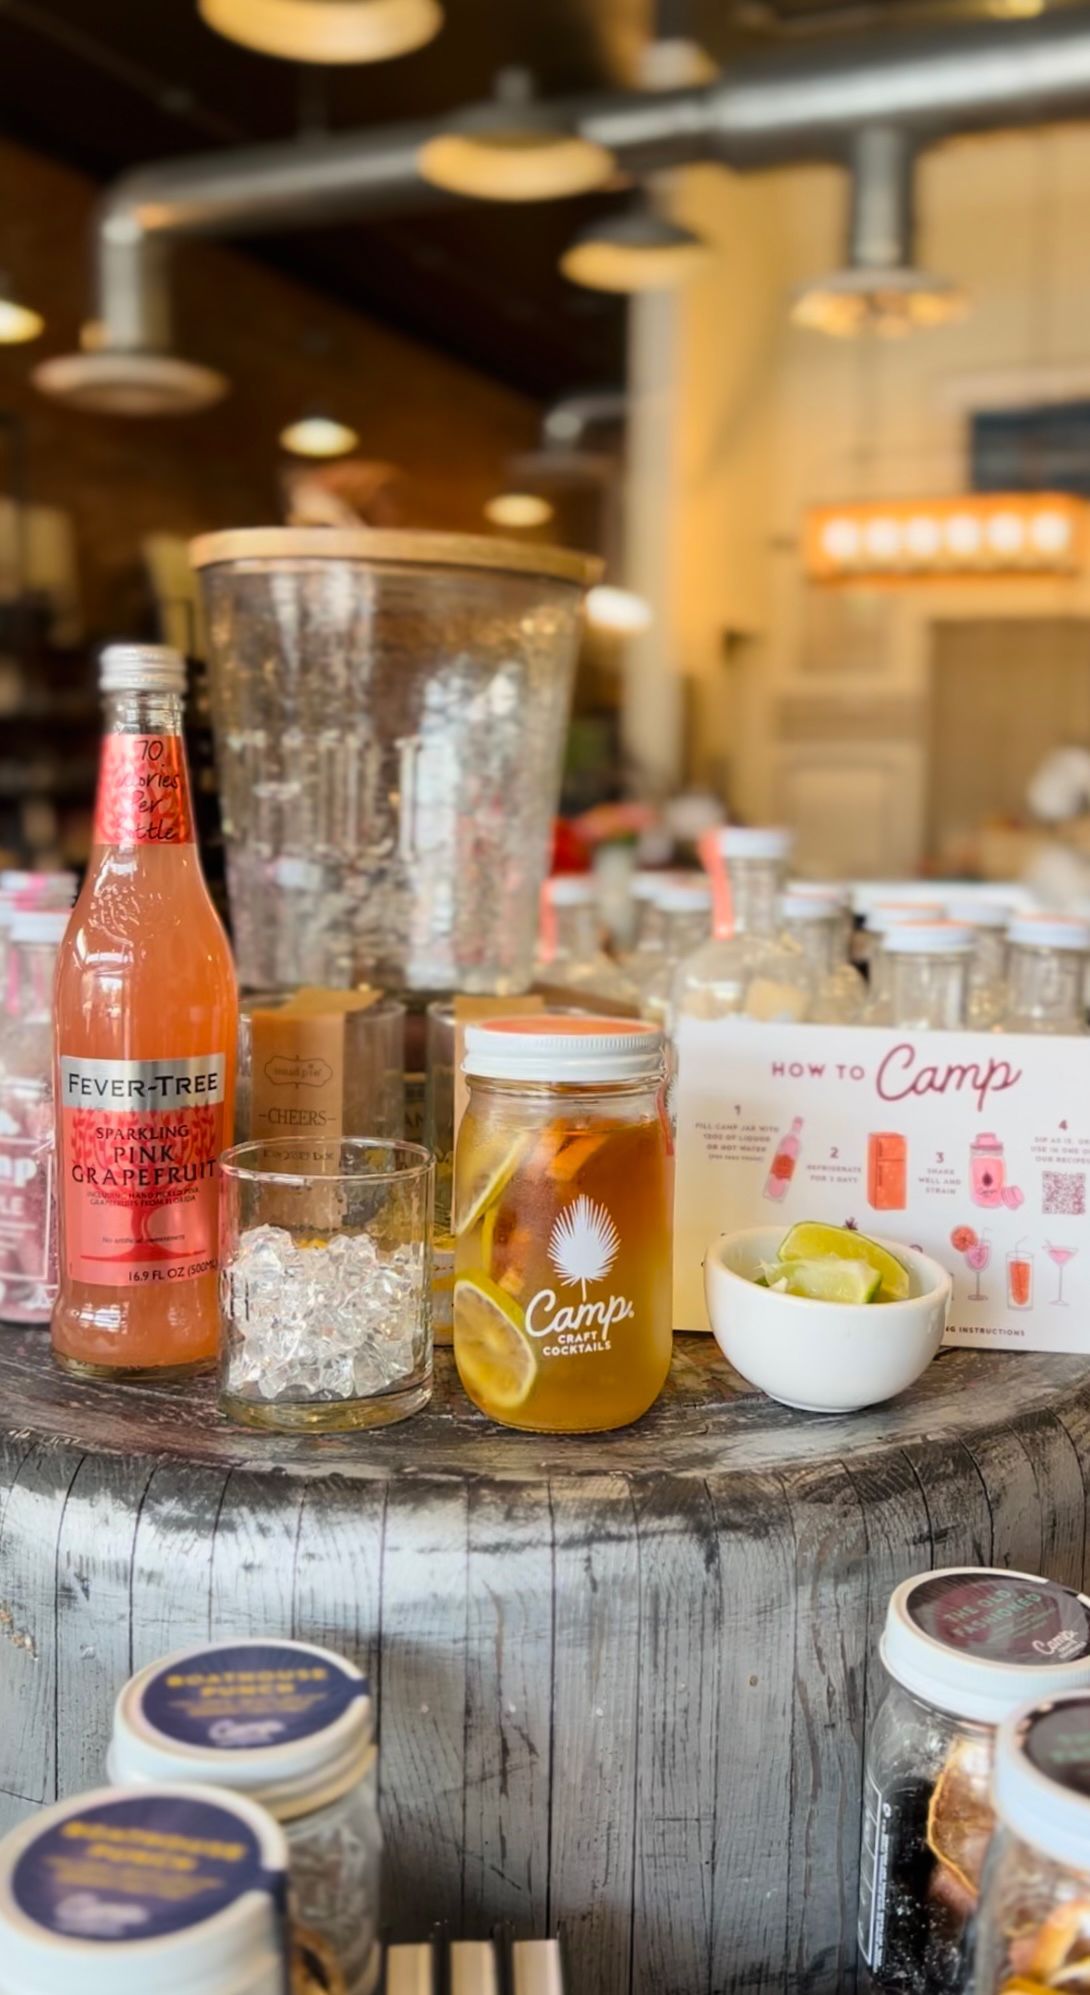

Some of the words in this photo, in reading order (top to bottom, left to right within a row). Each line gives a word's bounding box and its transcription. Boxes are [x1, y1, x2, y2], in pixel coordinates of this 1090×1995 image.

[134, 740, 164, 761] 70
[68, 1072, 219, 1098] FEVER-TREE
[772, 1061, 826, 1078] HOW
[836, 1064, 865, 1081] TO
[876, 1043, 1023, 1113] Camp
[734, 1104, 741, 1116] 1
[96, 1124, 190, 1141] SPARKLING
[1058, 1119, 1068, 1131] 4
[113, 1144, 176, 1164] PINK
[829, 1146, 840, 1159] 2
[935, 1152, 945, 1164] 3
[72, 1159, 217, 1187] GRAPEFRUIT
[128, 1270, 149, 1282] 16.9
[152, 1270, 165, 1281] FL
[167, 1266, 186, 1279] OZ
[557, 1330, 597, 1345] CRAFT
[958, 1325, 1026, 1337] INSTRUCTIONS
[542, 1340, 612, 1357] COCKTAILS
